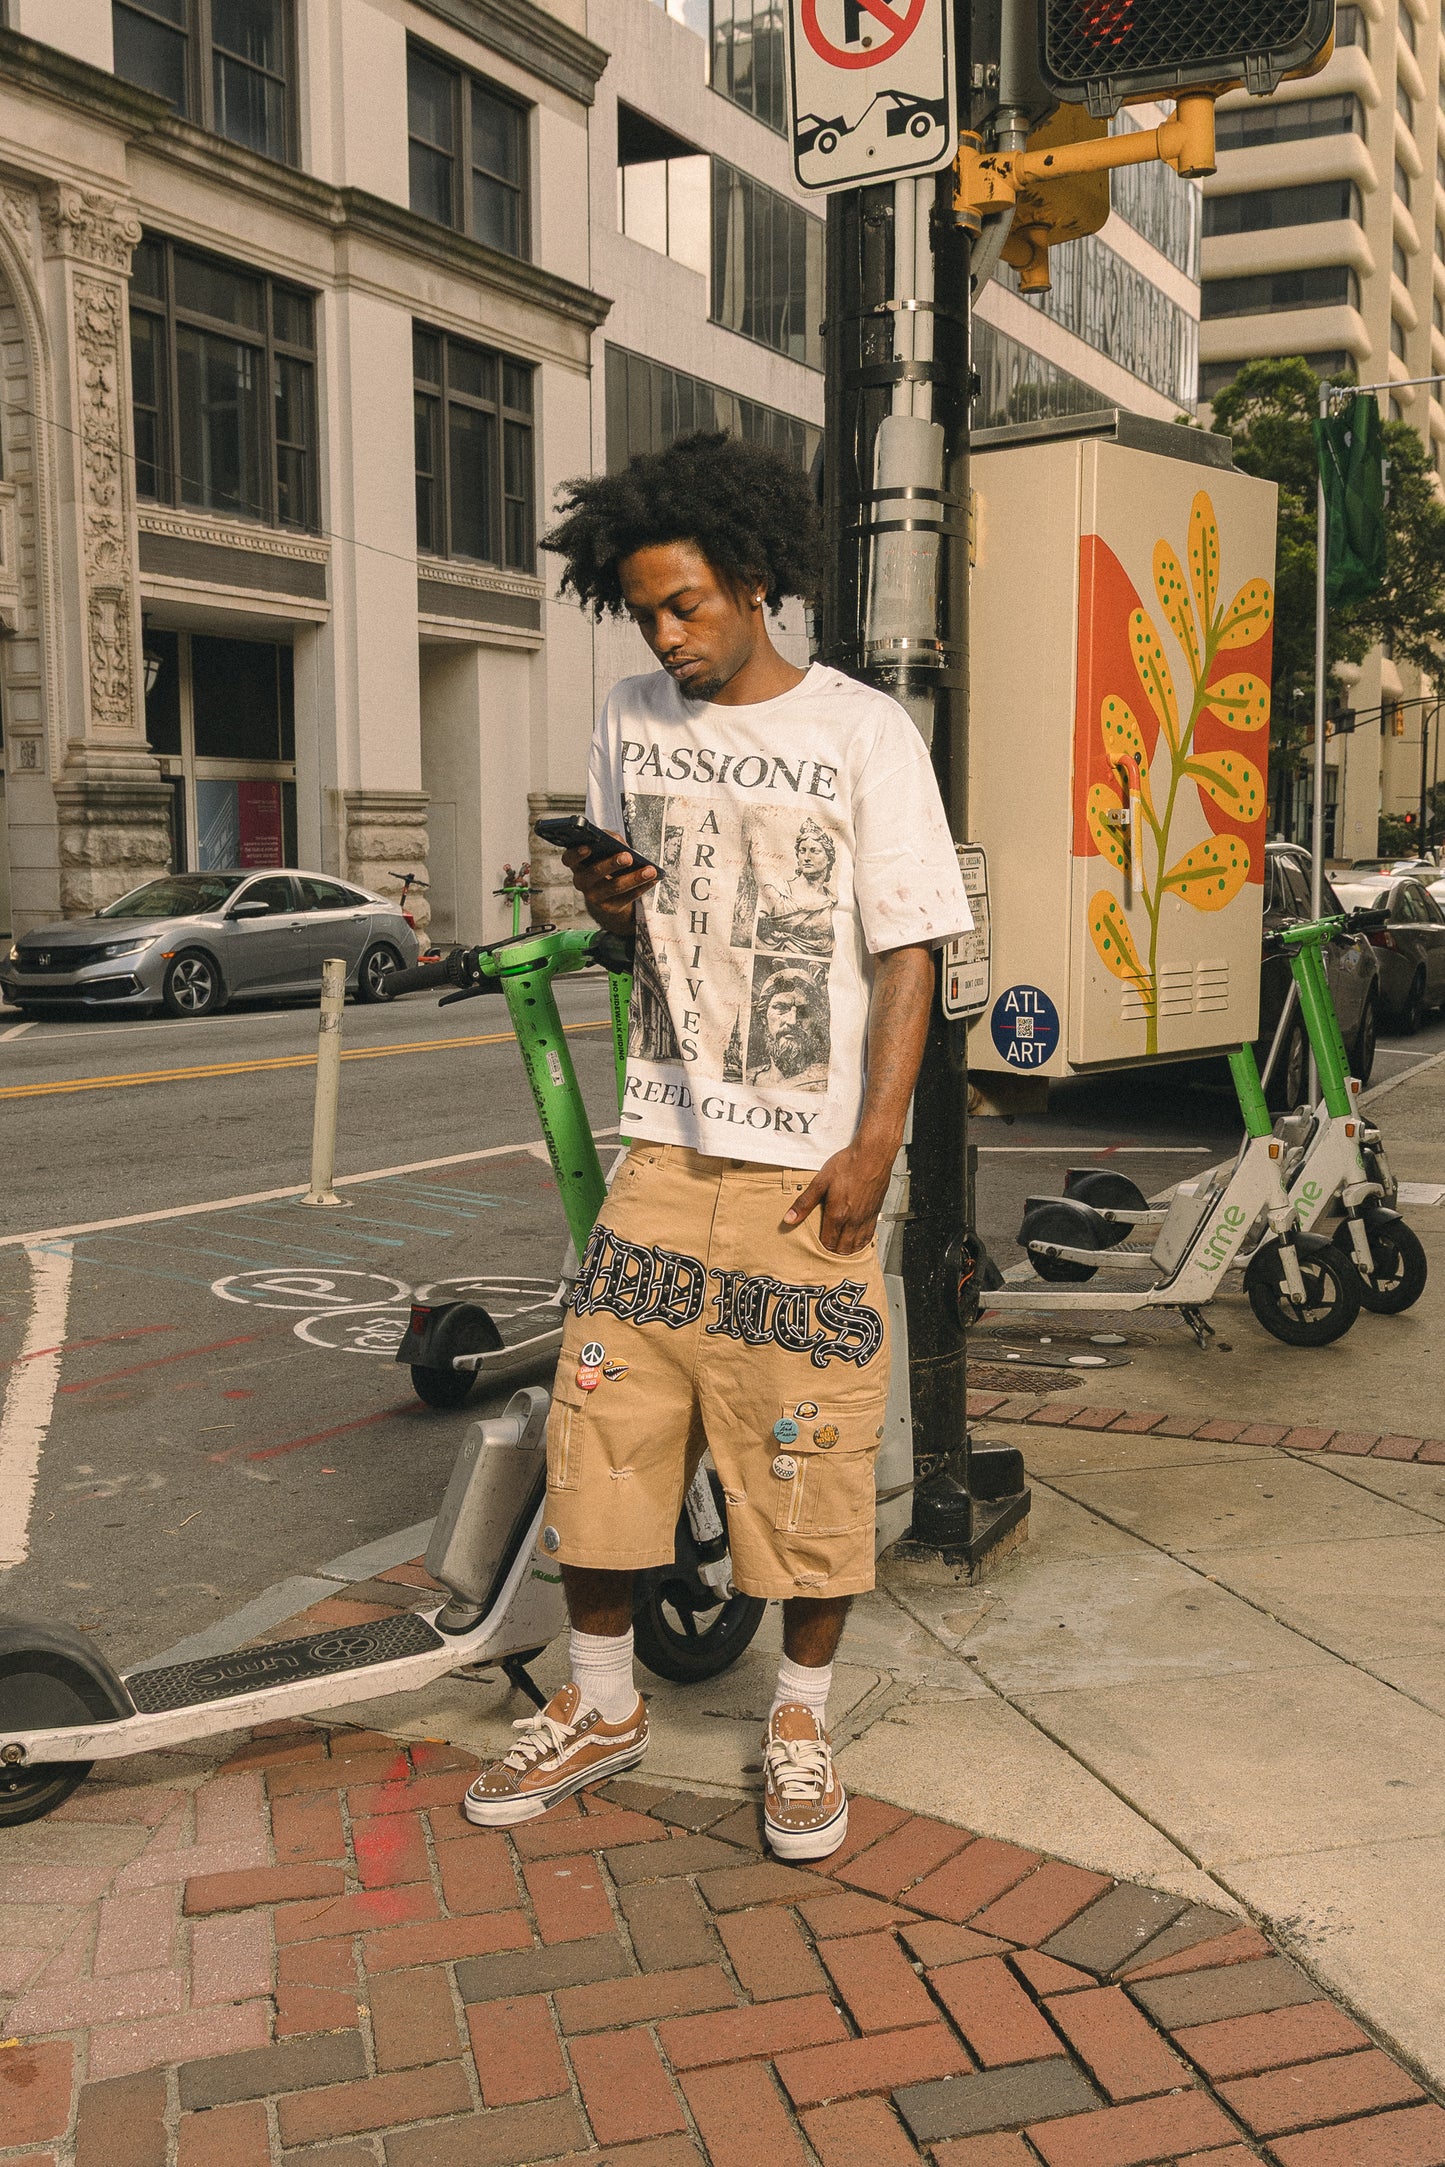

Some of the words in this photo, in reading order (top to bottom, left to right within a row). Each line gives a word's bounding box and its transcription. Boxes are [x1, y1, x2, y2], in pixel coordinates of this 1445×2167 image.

[621, 740, 838, 802] PASSIONE
[681, 809, 721, 1063] ARCHIVES
[612, 980, 619, 992] NO
[1004, 990, 1046, 1014] ATL
[613, 993, 624, 1034] SIDEWALK
[616, 1034, 625, 1061] RIDING
[1006, 1041, 1047, 1064] ART
[701, 1096, 818, 1135] GLORY
[1197, 1205, 1246, 1271] Lime
[570, 1223, 885, 1369] ADDICTS
